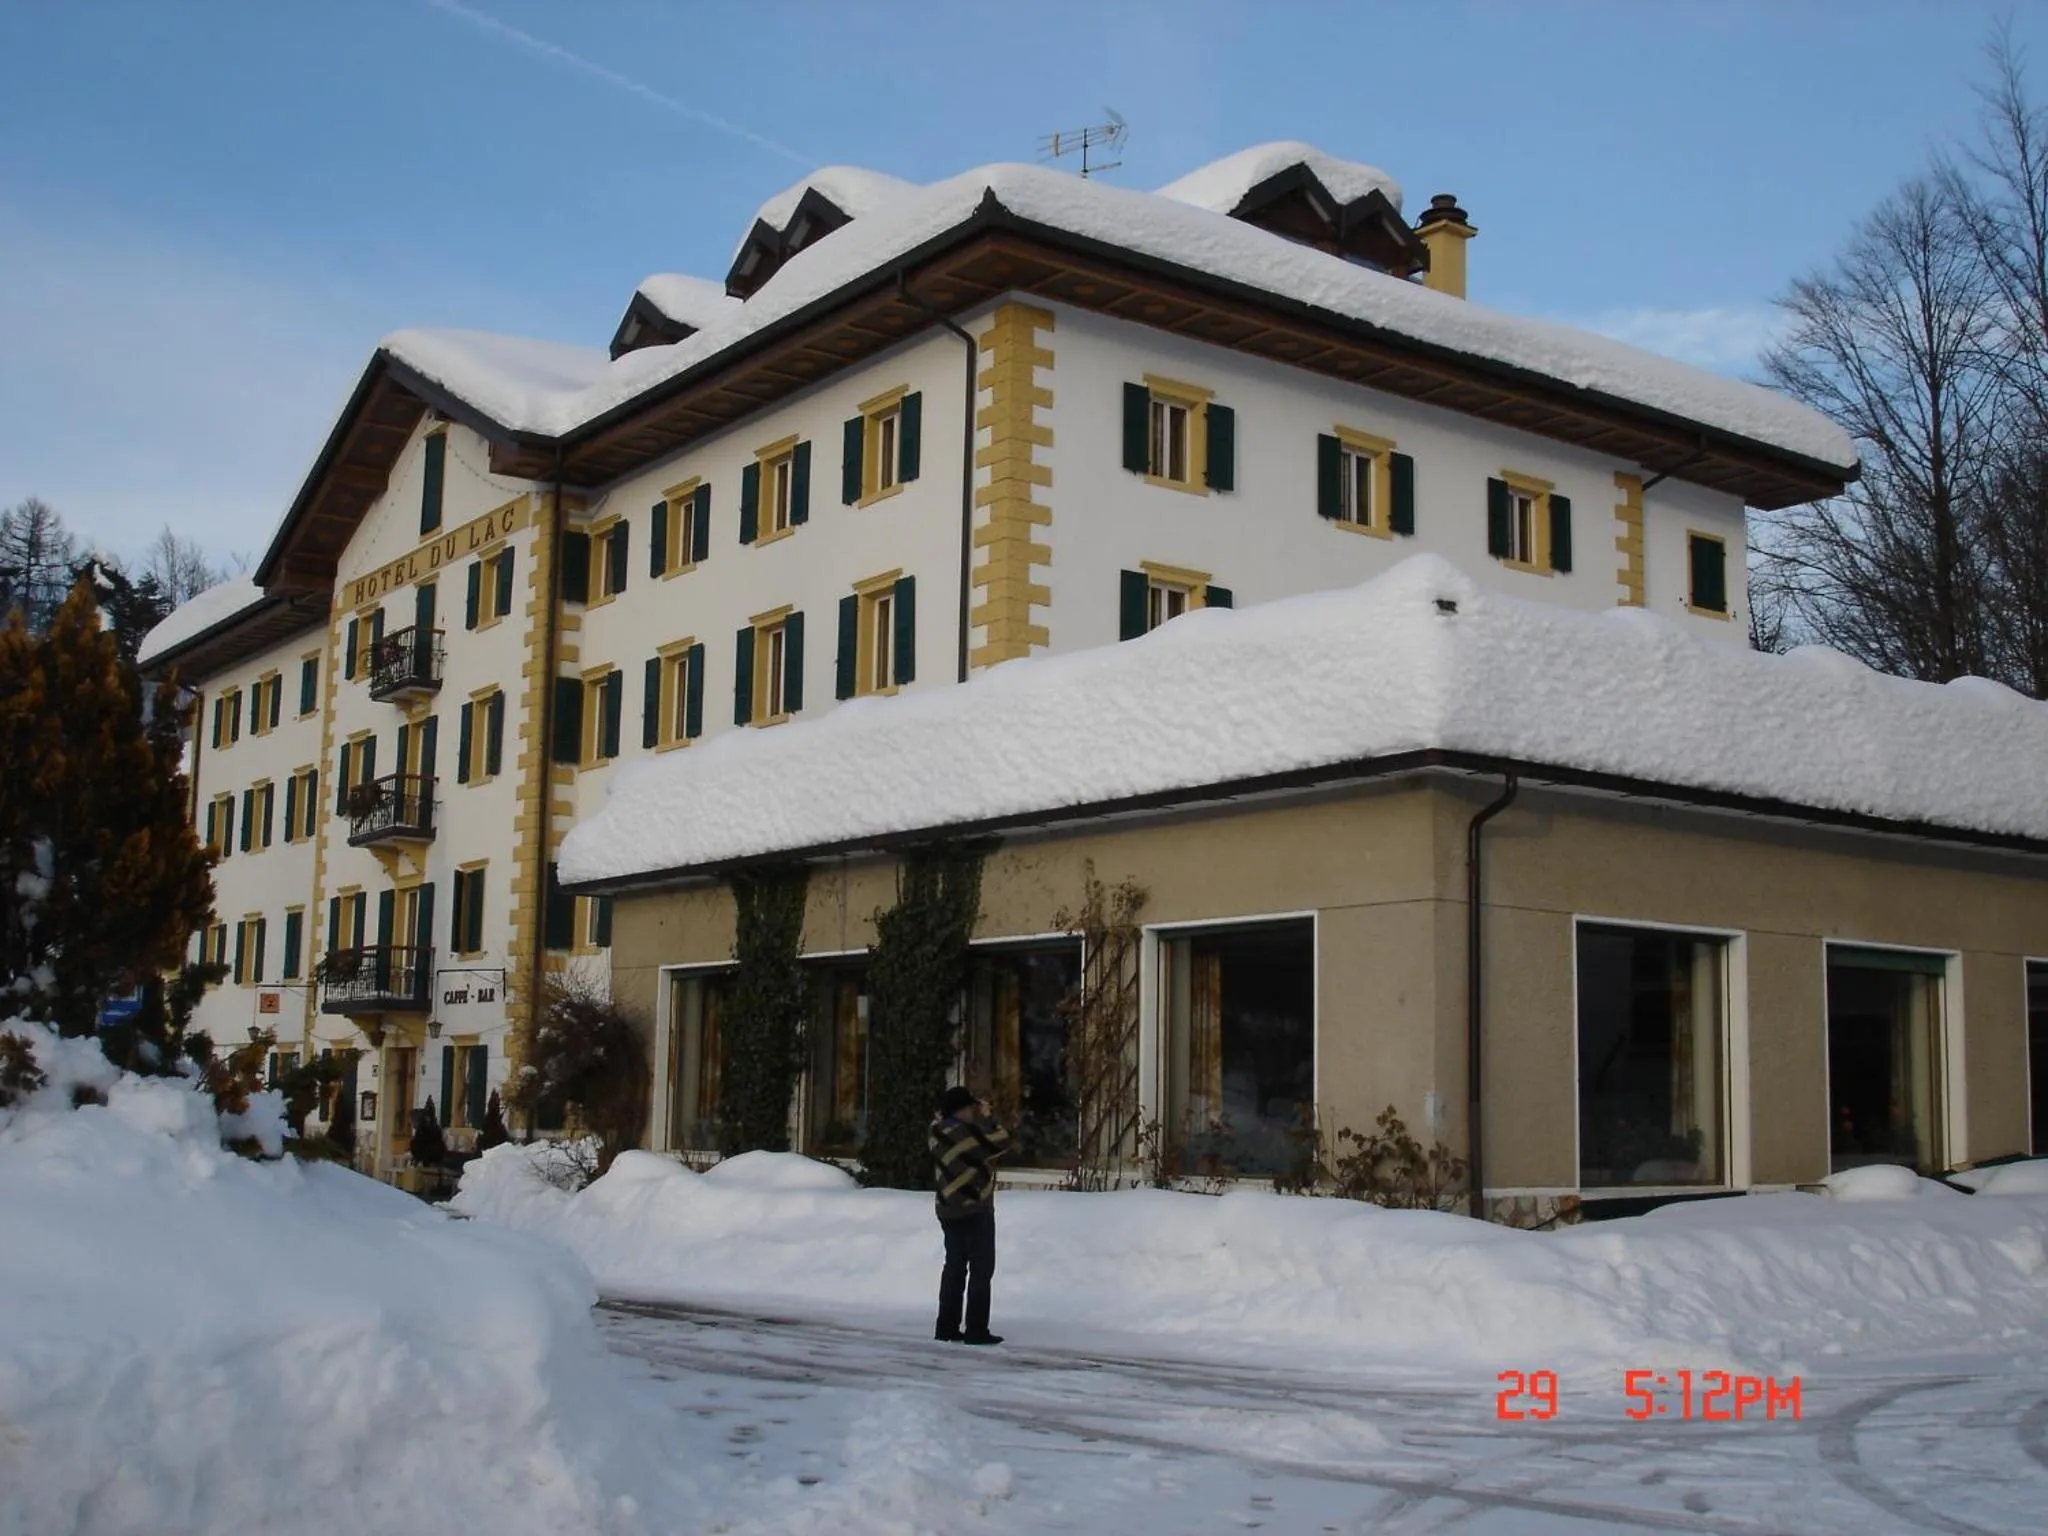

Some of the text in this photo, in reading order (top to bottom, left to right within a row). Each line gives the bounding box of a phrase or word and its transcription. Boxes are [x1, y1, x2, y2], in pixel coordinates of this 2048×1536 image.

[354, 508, 514, 604] HOTEL DU LAC
[477, 988, 495, 1003] BAR
